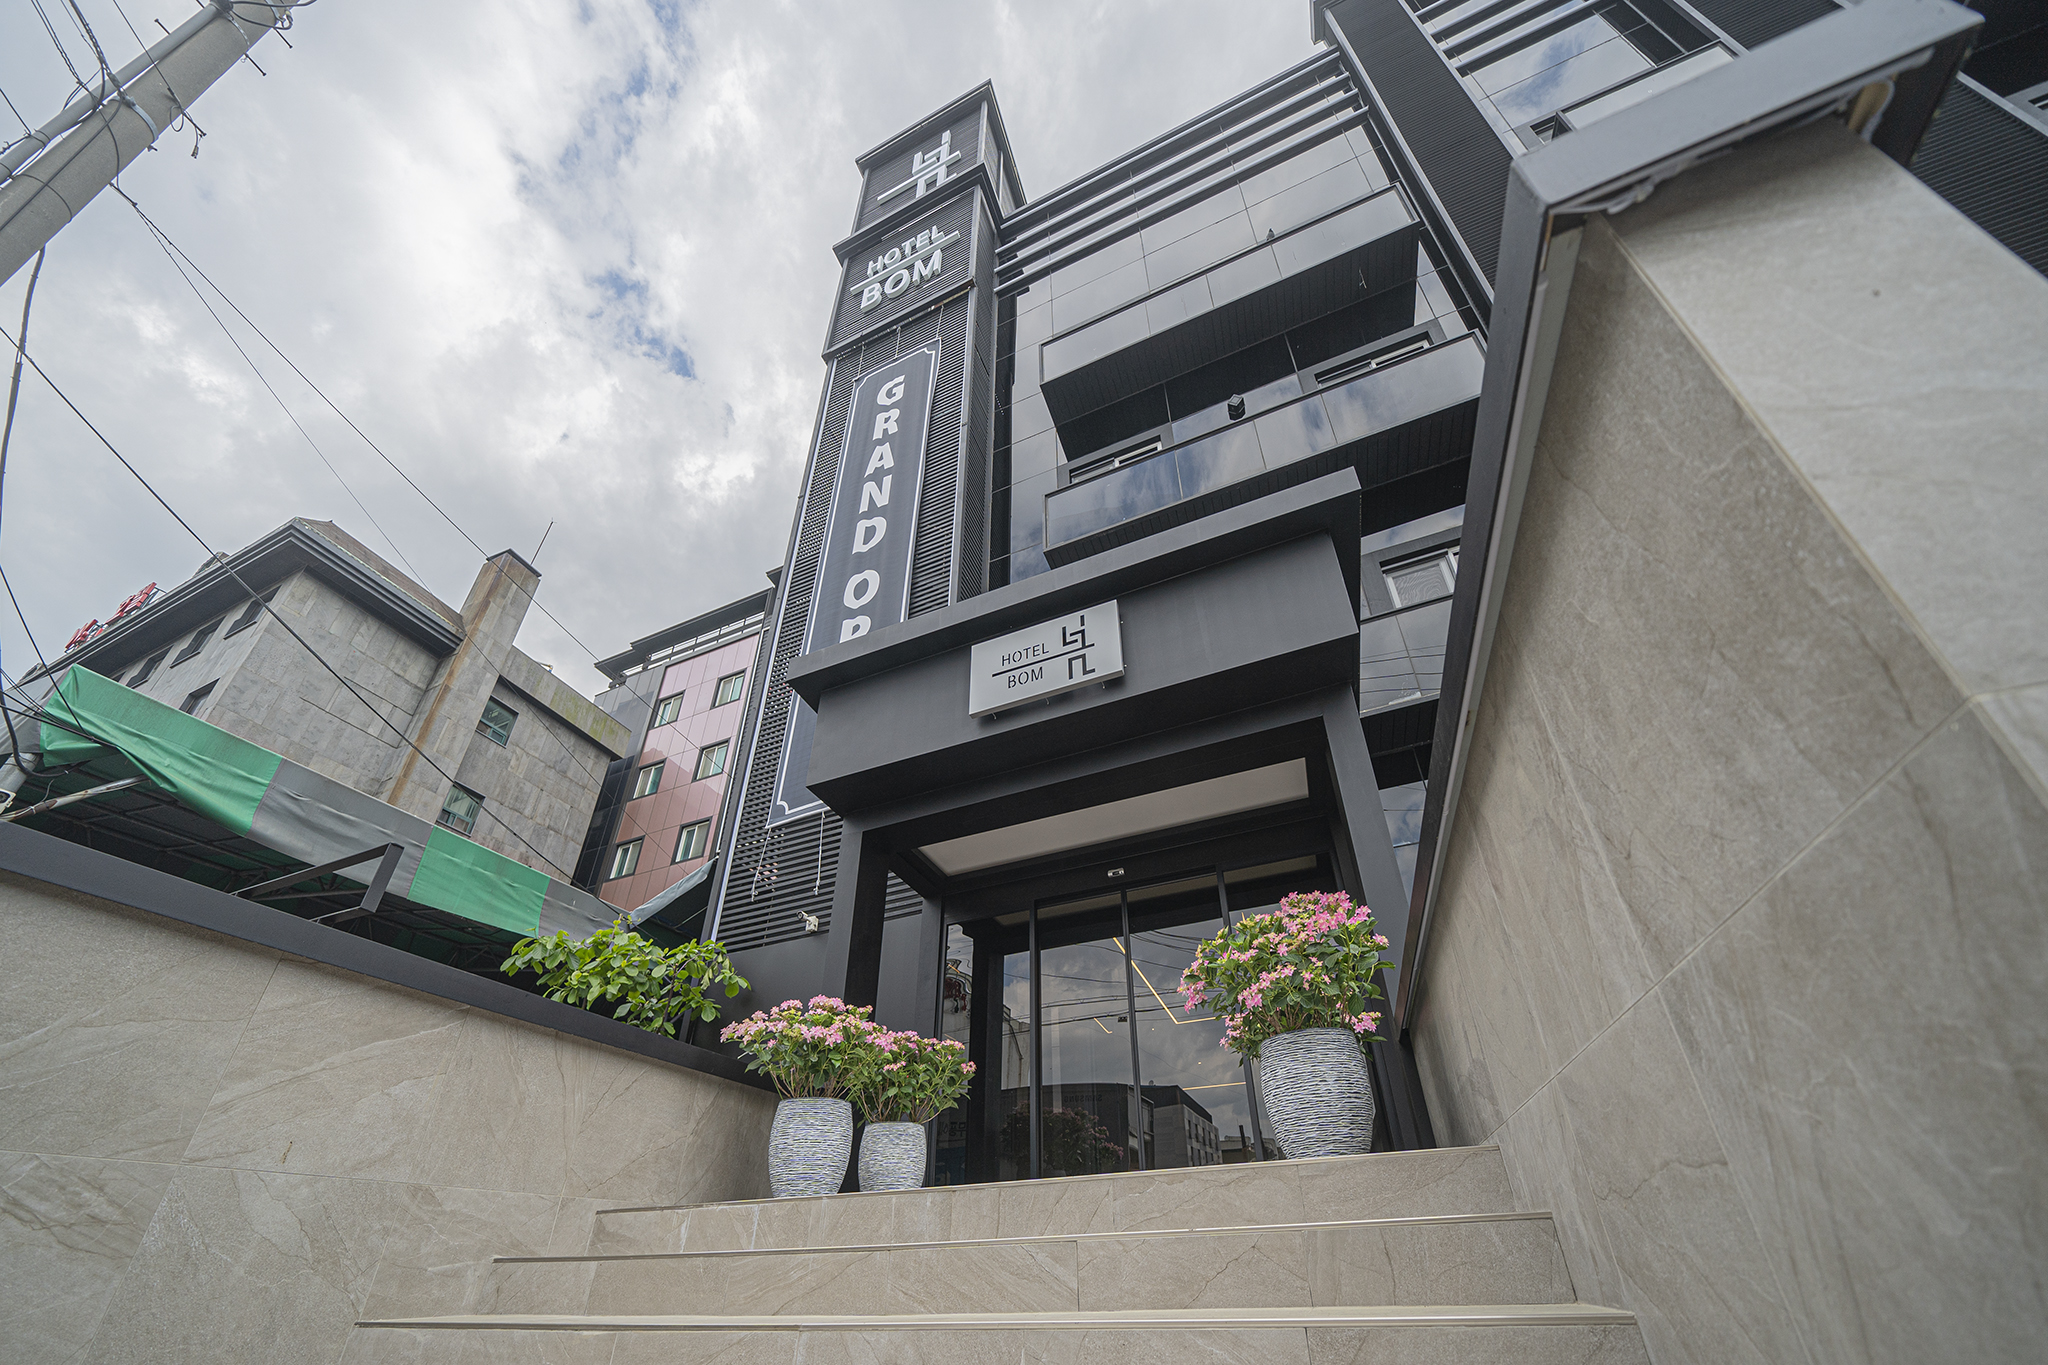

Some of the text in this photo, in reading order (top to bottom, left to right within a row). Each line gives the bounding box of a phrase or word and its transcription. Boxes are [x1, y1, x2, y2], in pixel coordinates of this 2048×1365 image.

[867, 225, 945, 277] HOTEL
[861, 249, 943, 314] BOM
[852, 375, 905, 555] GRAND
[1001, 643, 1050, 666] HOTEL
[1007, 666, 1044, 689] BOM
